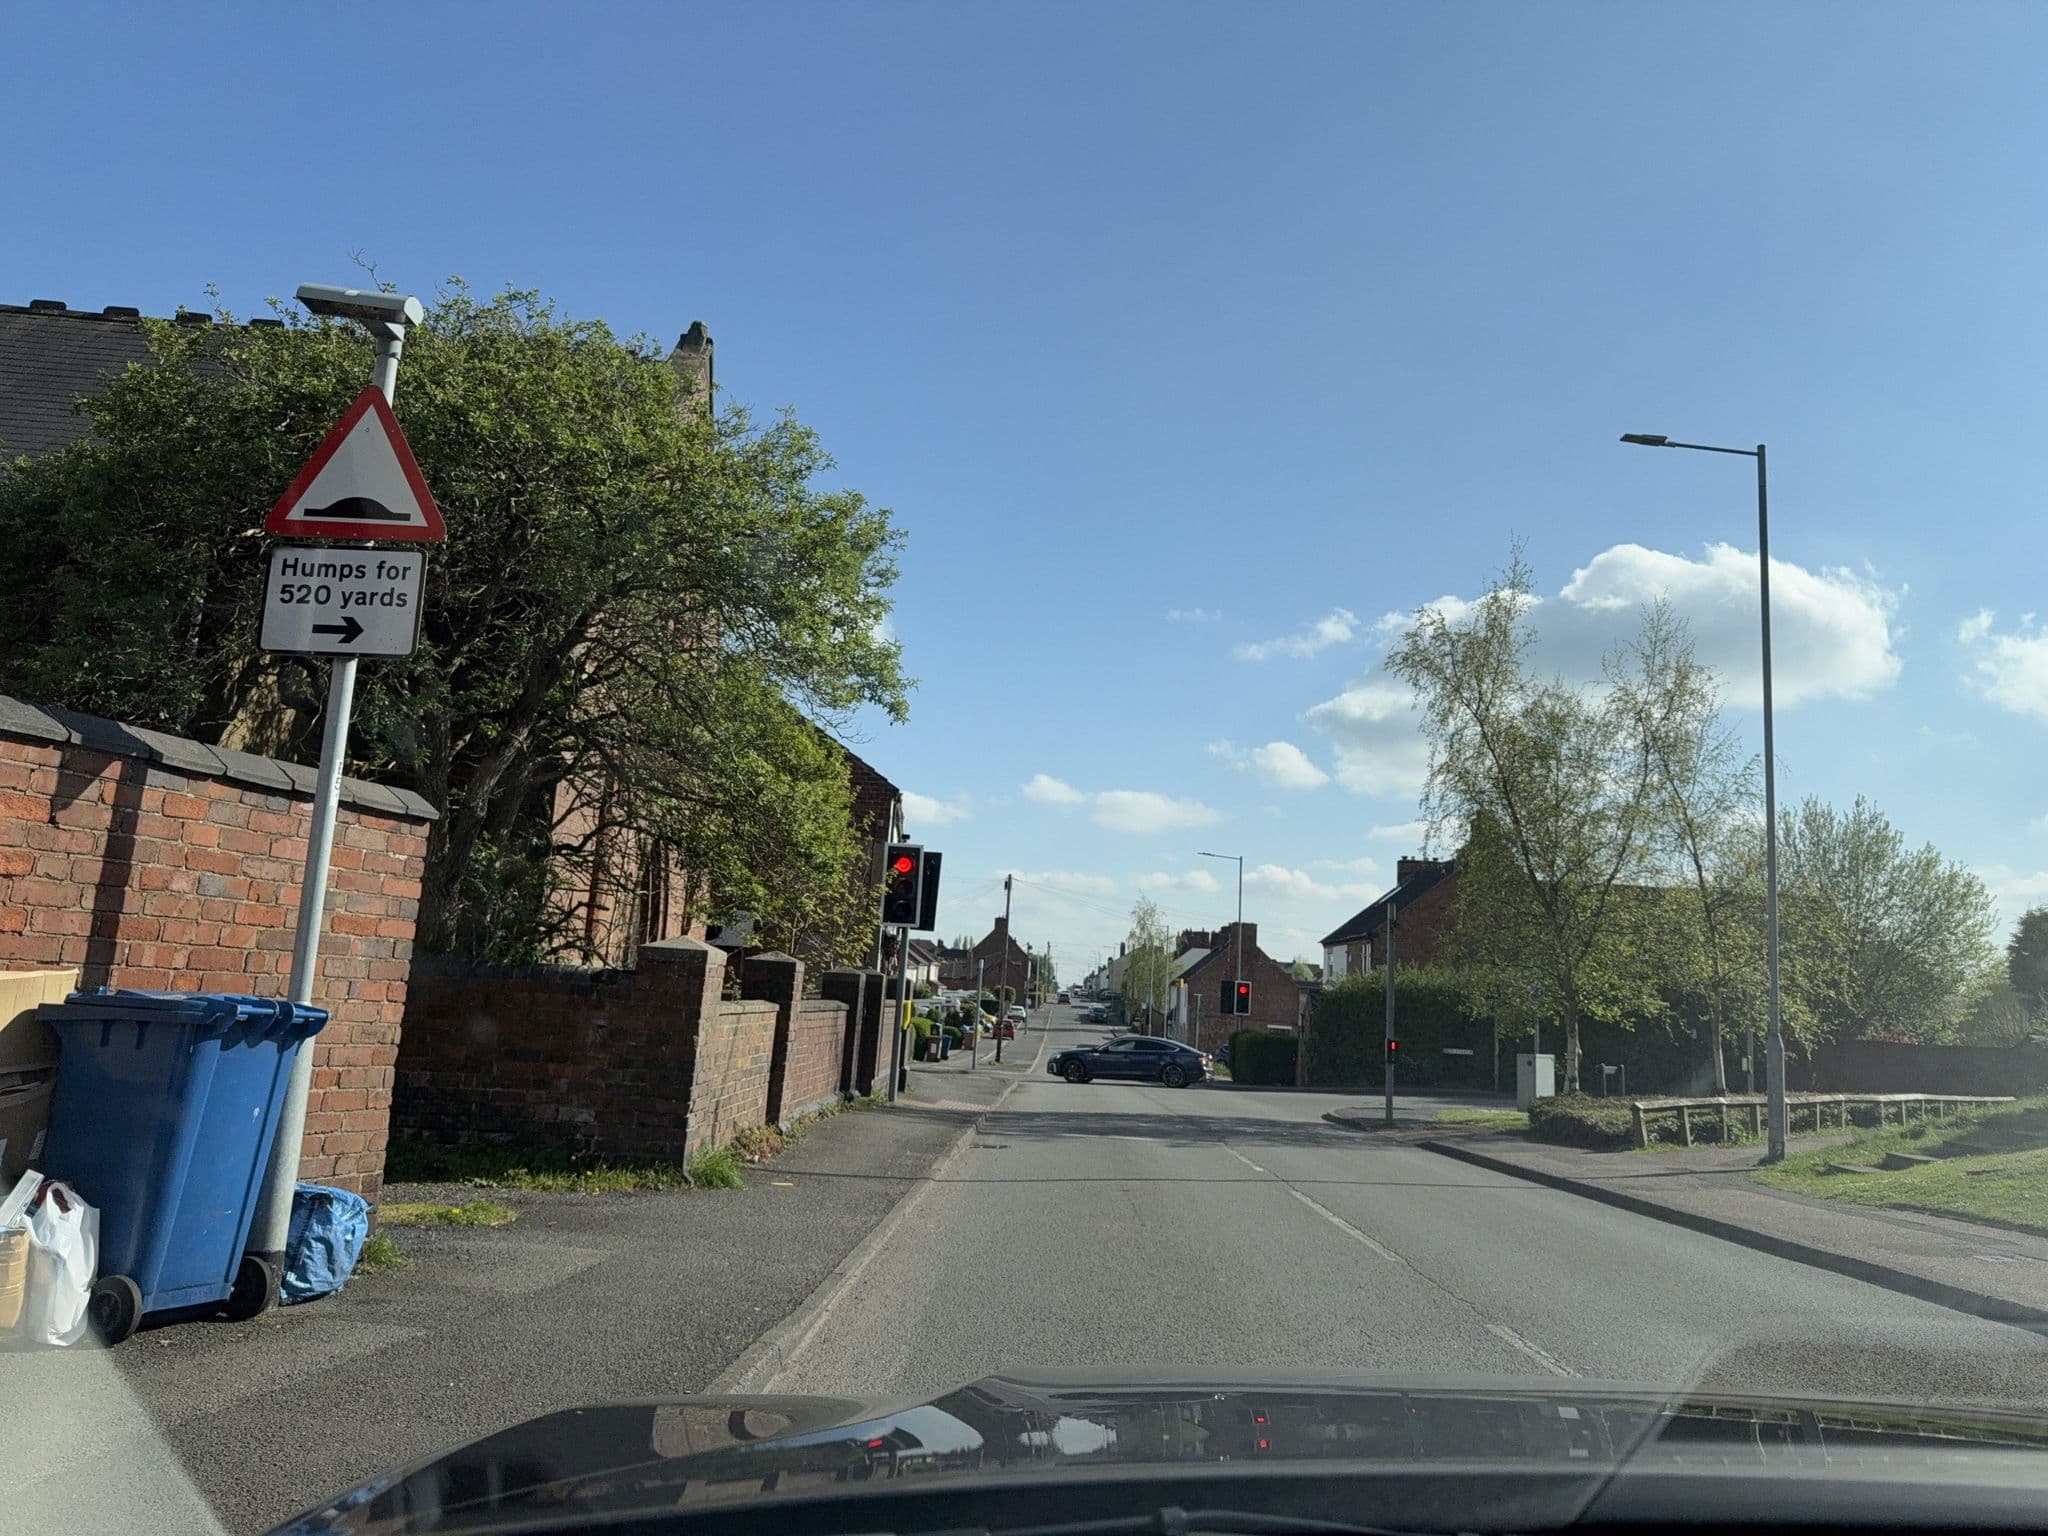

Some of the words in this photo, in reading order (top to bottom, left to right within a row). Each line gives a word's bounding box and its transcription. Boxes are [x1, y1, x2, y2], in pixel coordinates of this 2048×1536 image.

[281, 556, 367, 582] Humps
[376, 560, 411, 580] for
[279, 584, 331, 605] 520
[340, 587, 408, 609] yards
